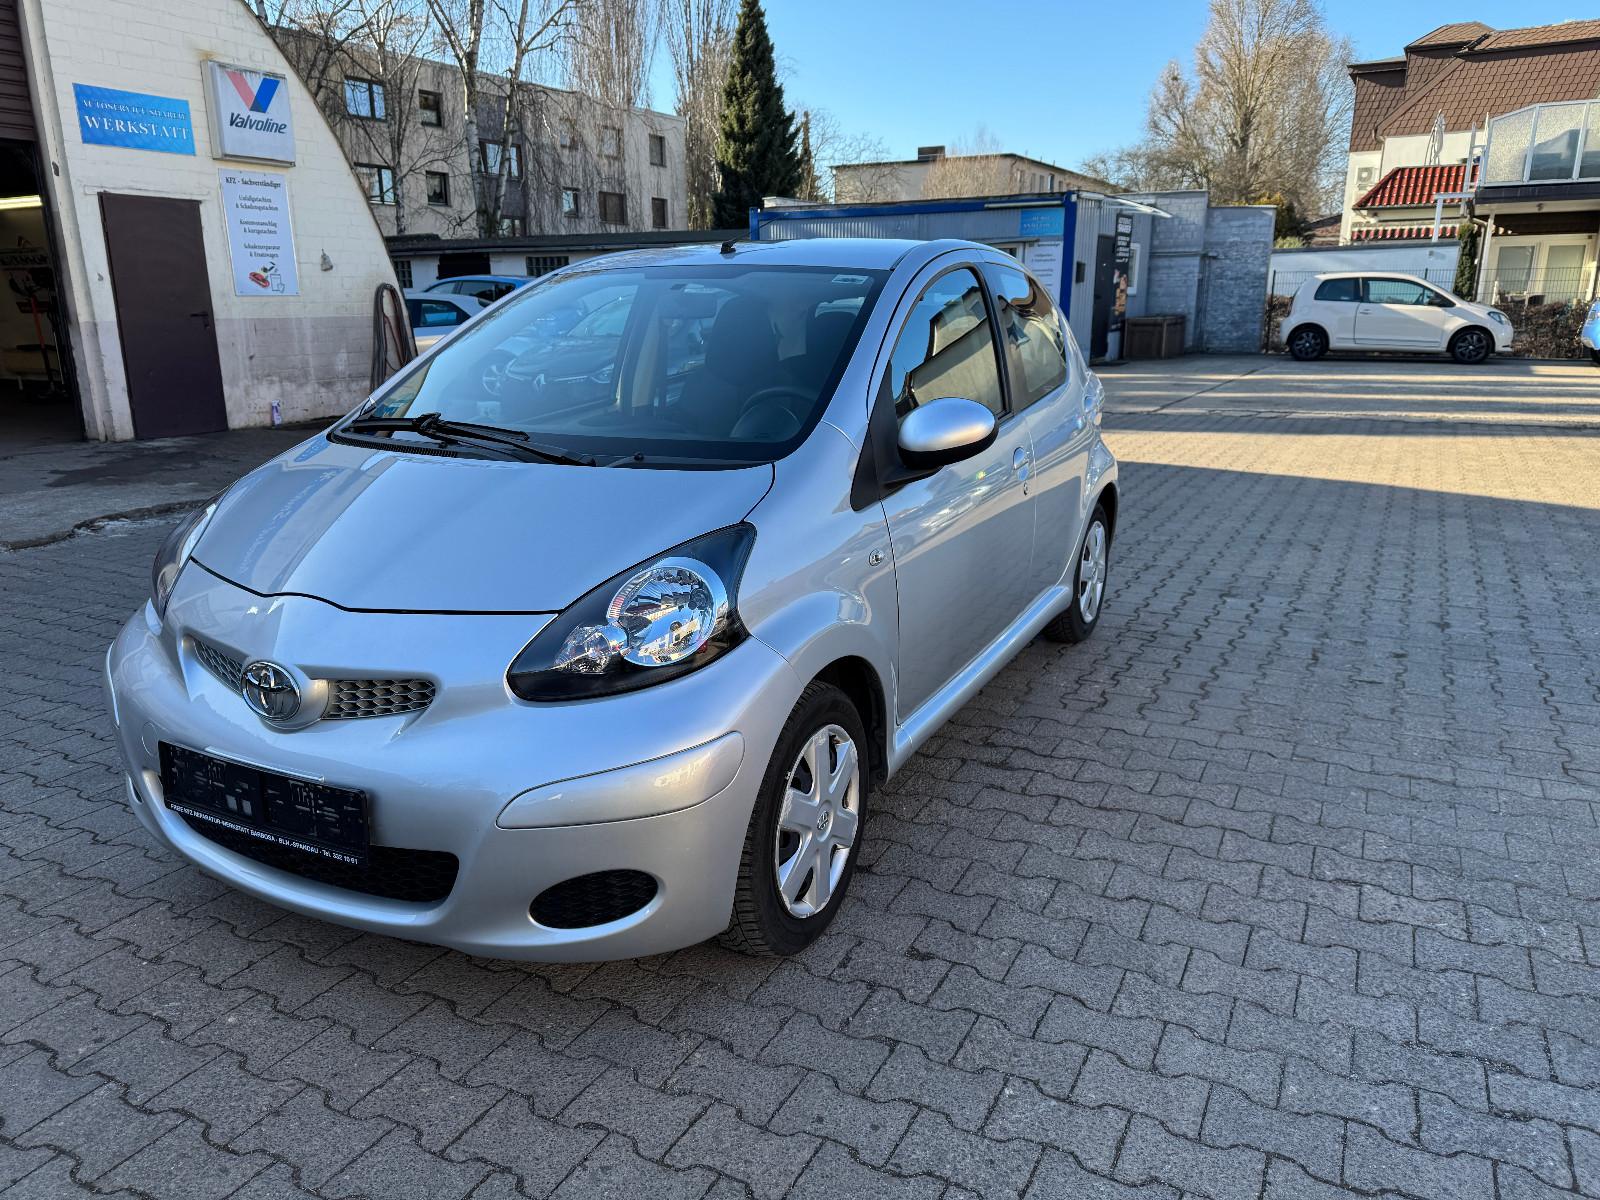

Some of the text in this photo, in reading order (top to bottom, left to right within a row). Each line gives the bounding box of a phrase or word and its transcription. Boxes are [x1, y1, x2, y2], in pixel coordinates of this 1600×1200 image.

[84, 115, 189, 139] WERKSTATT
[229, 112, 288, 134] Valvoline
[225, 176, 236, 184] KFZ
[250, 829, 276, 842] BARBOSA
